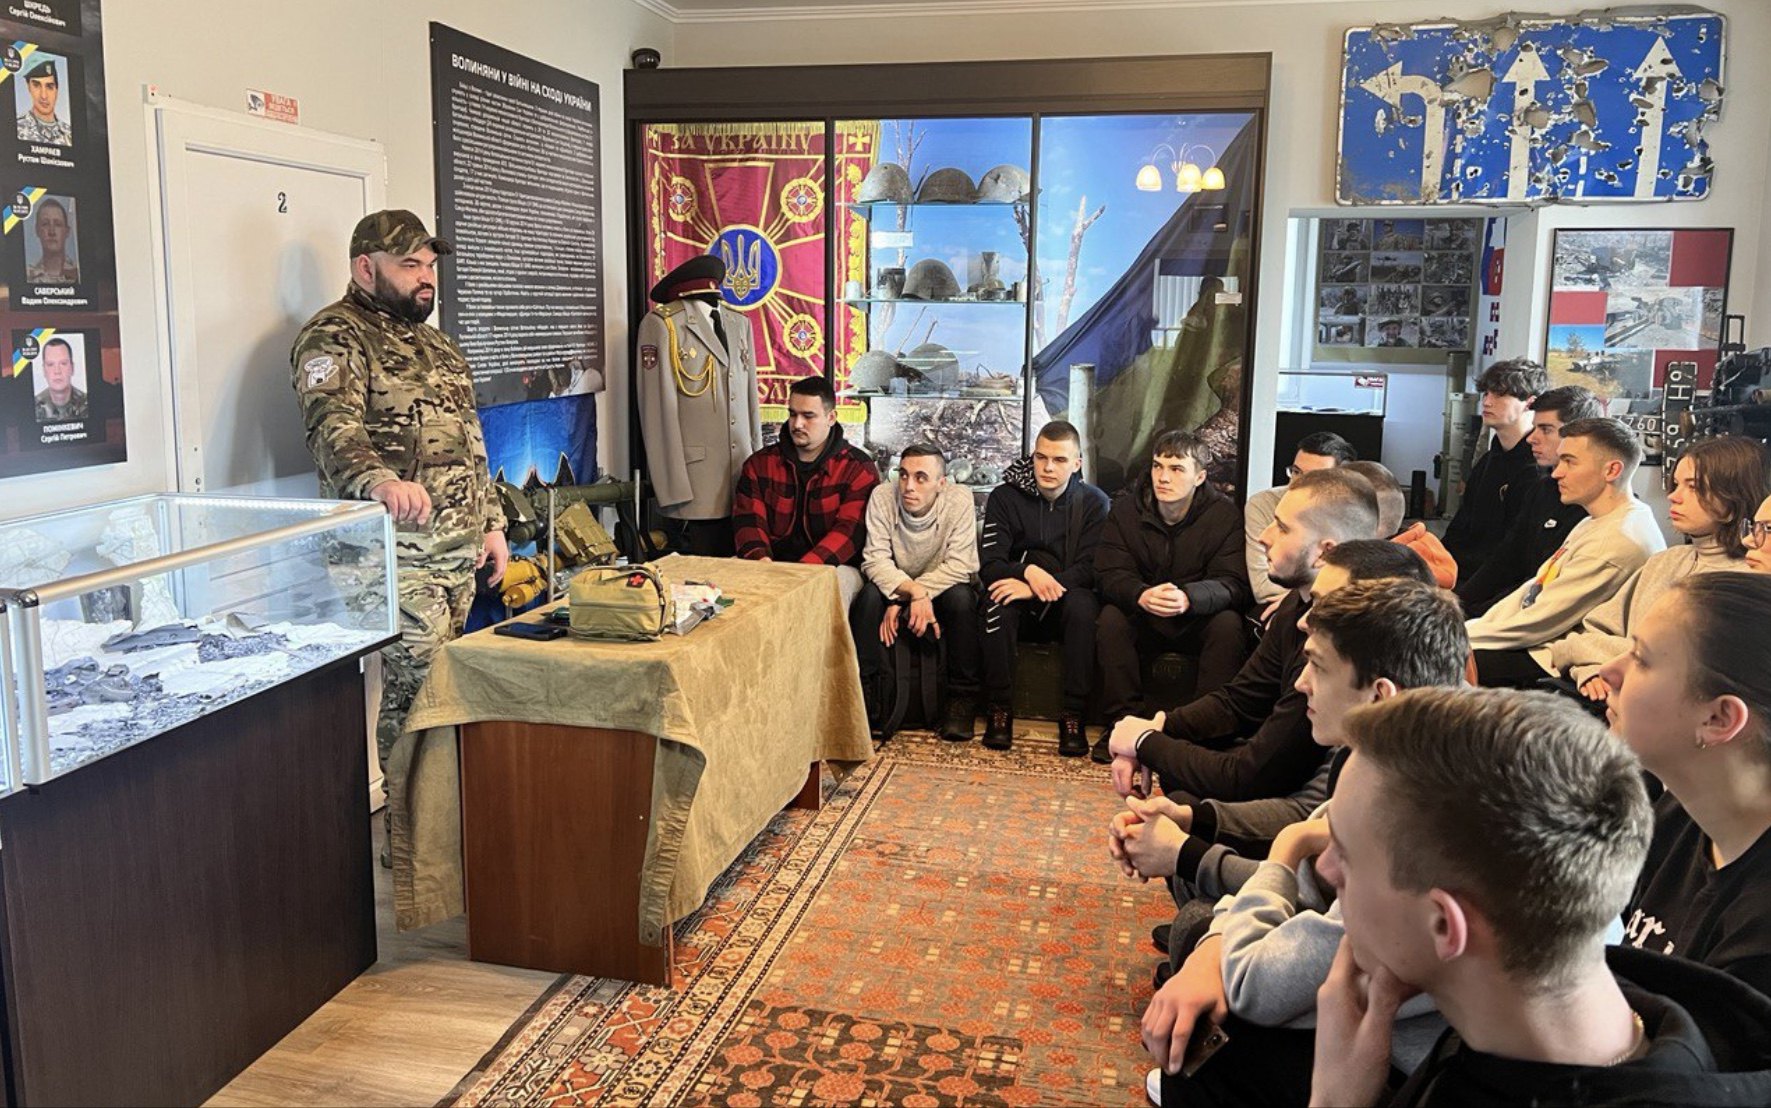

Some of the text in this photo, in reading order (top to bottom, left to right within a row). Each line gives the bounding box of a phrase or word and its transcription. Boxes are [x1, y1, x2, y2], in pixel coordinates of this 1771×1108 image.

[452, 53, 500, 82] ВОЛИНЯНИ
[508, 72, 529, 92] ВІЙНІ
[530, 81, 541, 96] НА
[541, 84, 563, 105] СХОДІ
[563, 92, 592, 112] УКРАЇНИ
[277, 191, 288, 214] 2
